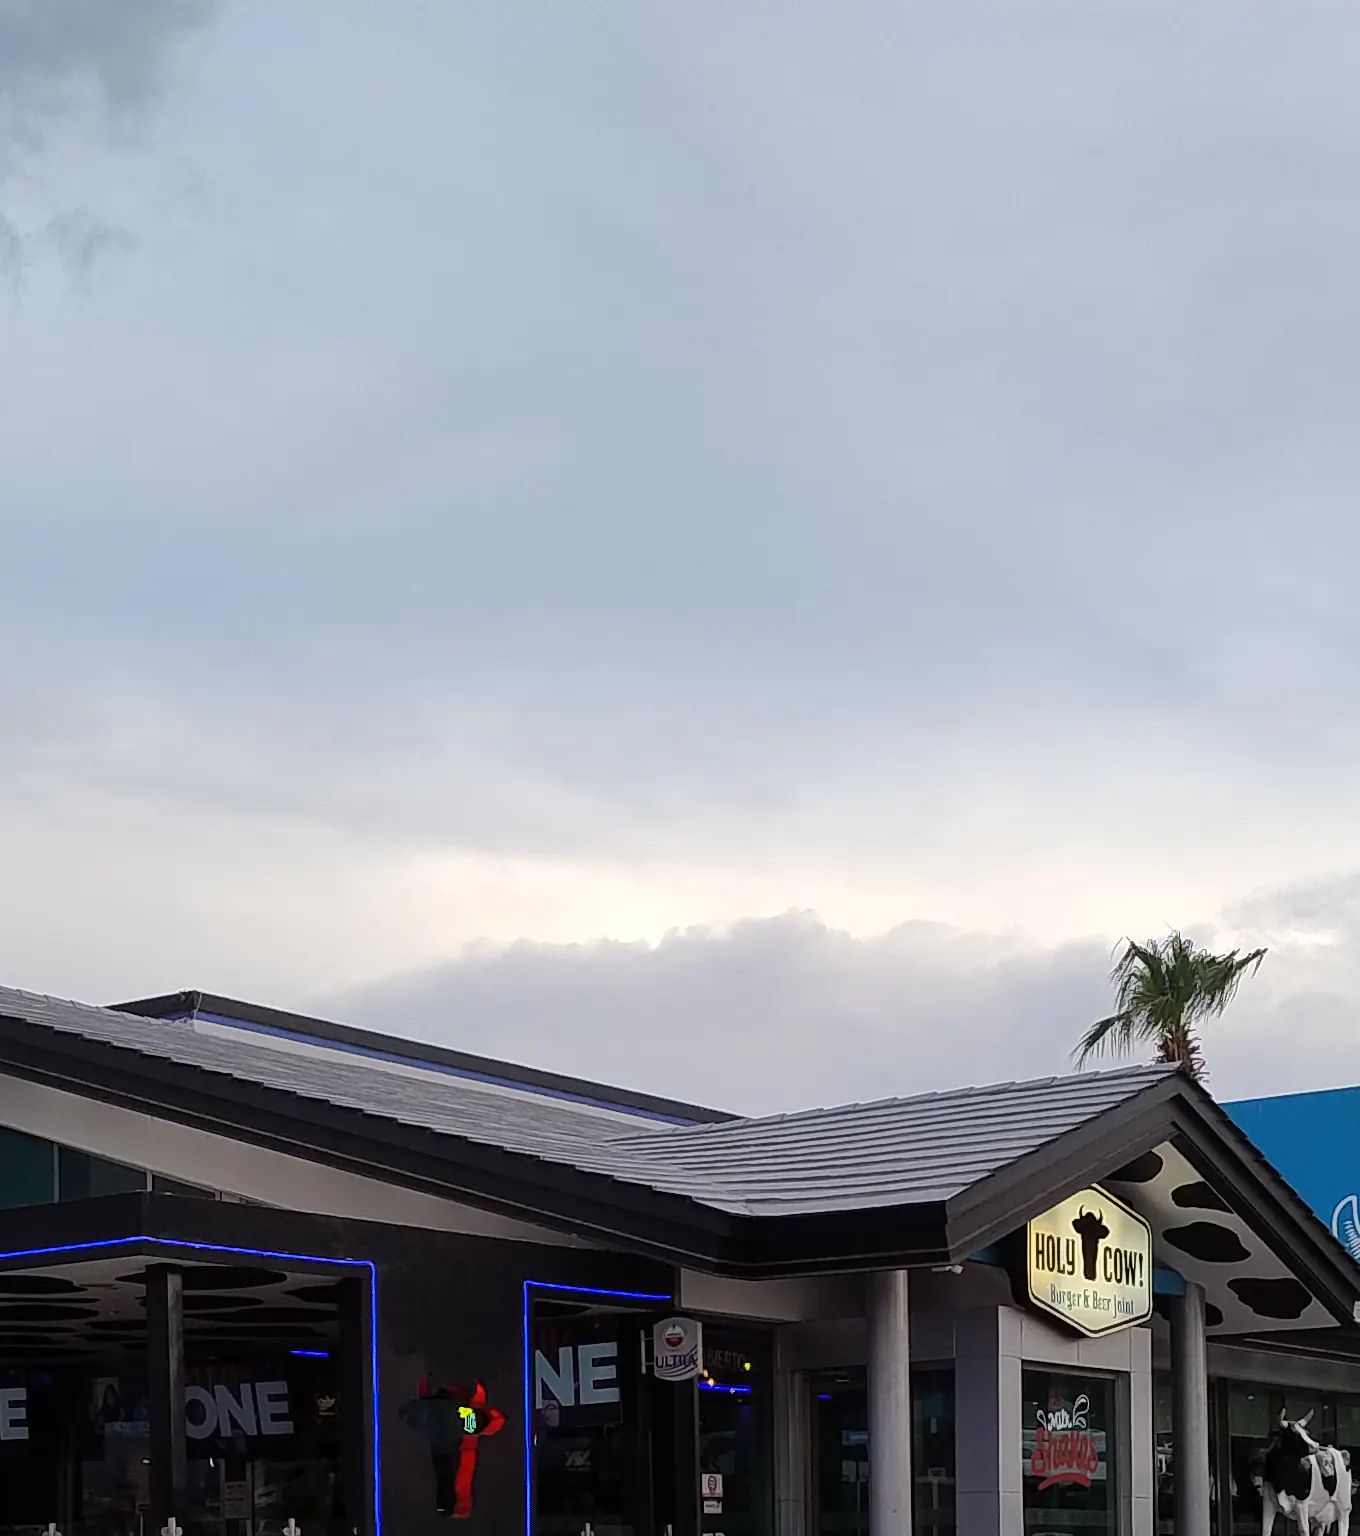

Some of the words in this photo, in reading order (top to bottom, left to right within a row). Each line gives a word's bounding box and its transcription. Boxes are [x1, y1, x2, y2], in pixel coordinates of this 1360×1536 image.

[1035, 1232, 1076, 1276] HOLY
[1103, 1246, 1144, 1288] COW!
[1050, 1283, 1082, 1311] Burger
[1083, 1289, 1090, 1308] &
[1092, 1290, 1112, 1312] Beer
[1112, 1294, 1134, 1319] Joint
[185, 1380, 295, 1440] ONE
